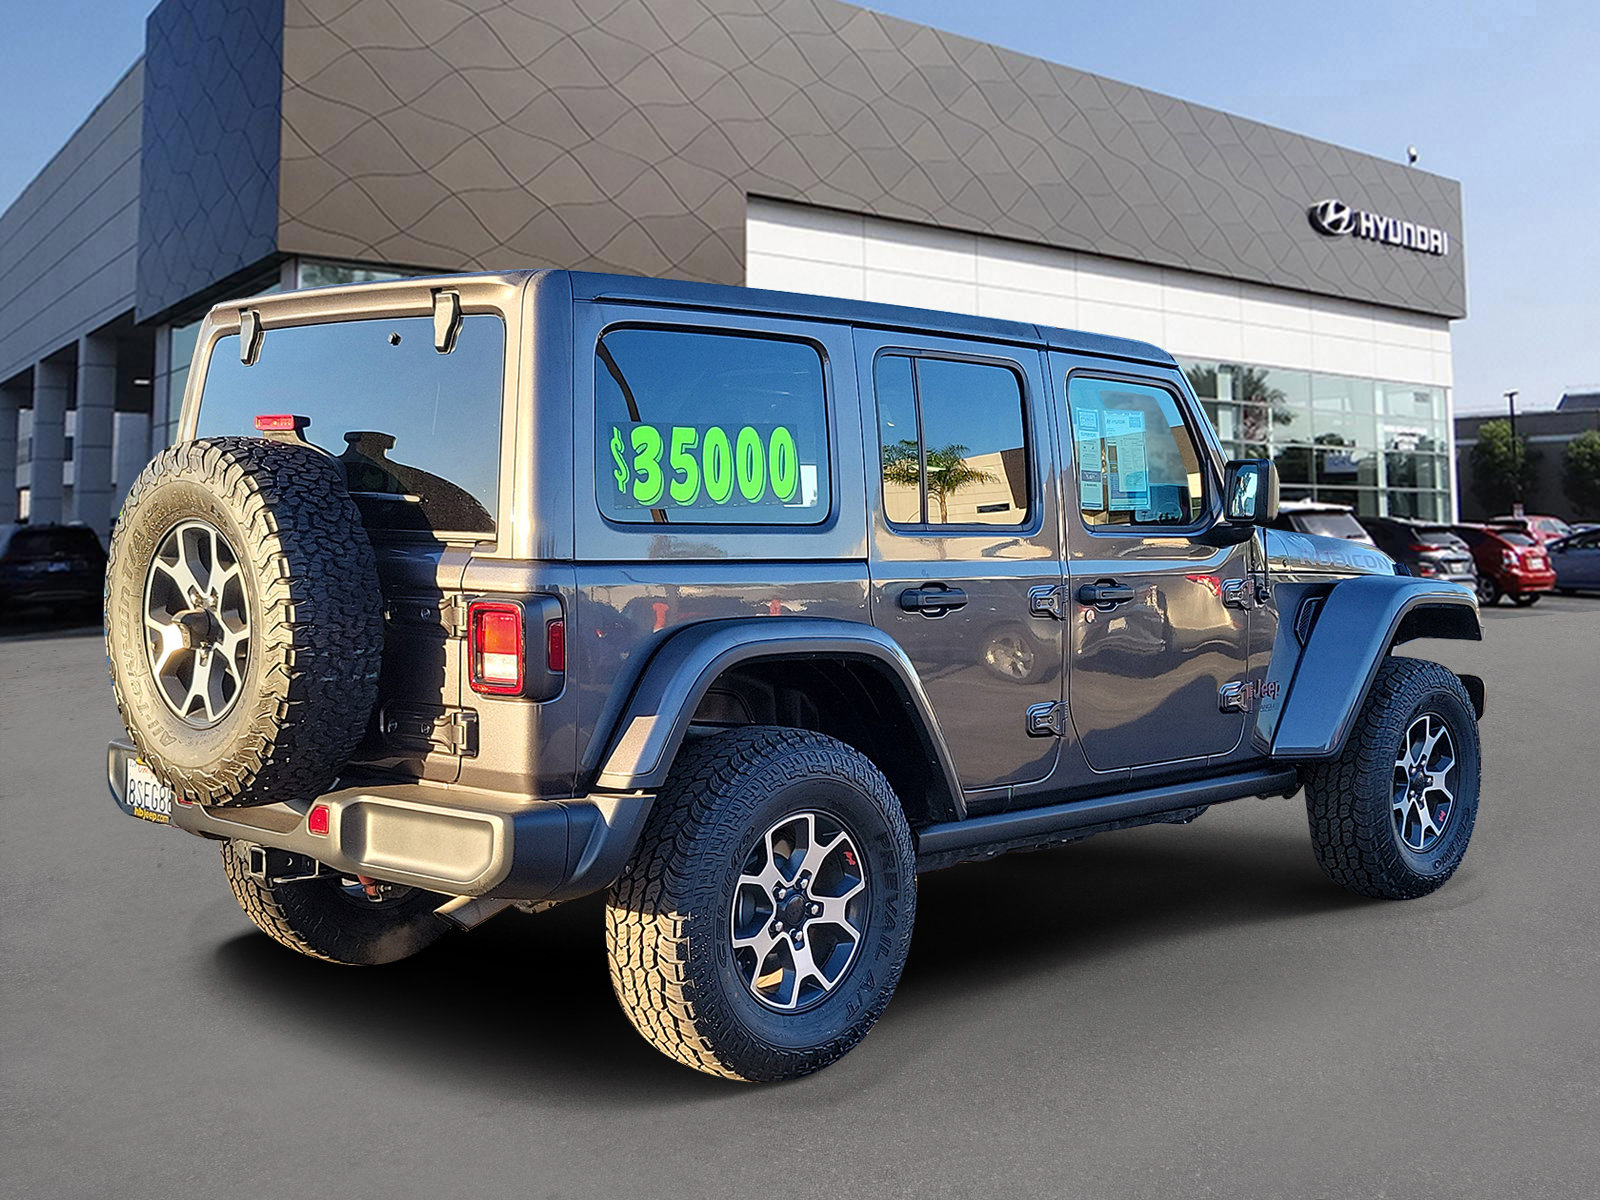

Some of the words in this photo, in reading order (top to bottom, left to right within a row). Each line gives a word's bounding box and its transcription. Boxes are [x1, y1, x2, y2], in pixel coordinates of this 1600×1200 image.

[1359, 211, 1449, 256] HYUNDAI
[610, 425, 799, 506] $35000
[1299, 549, 1391, 571] RUBICON
[1253, 679, 1282, 699] Jeep
